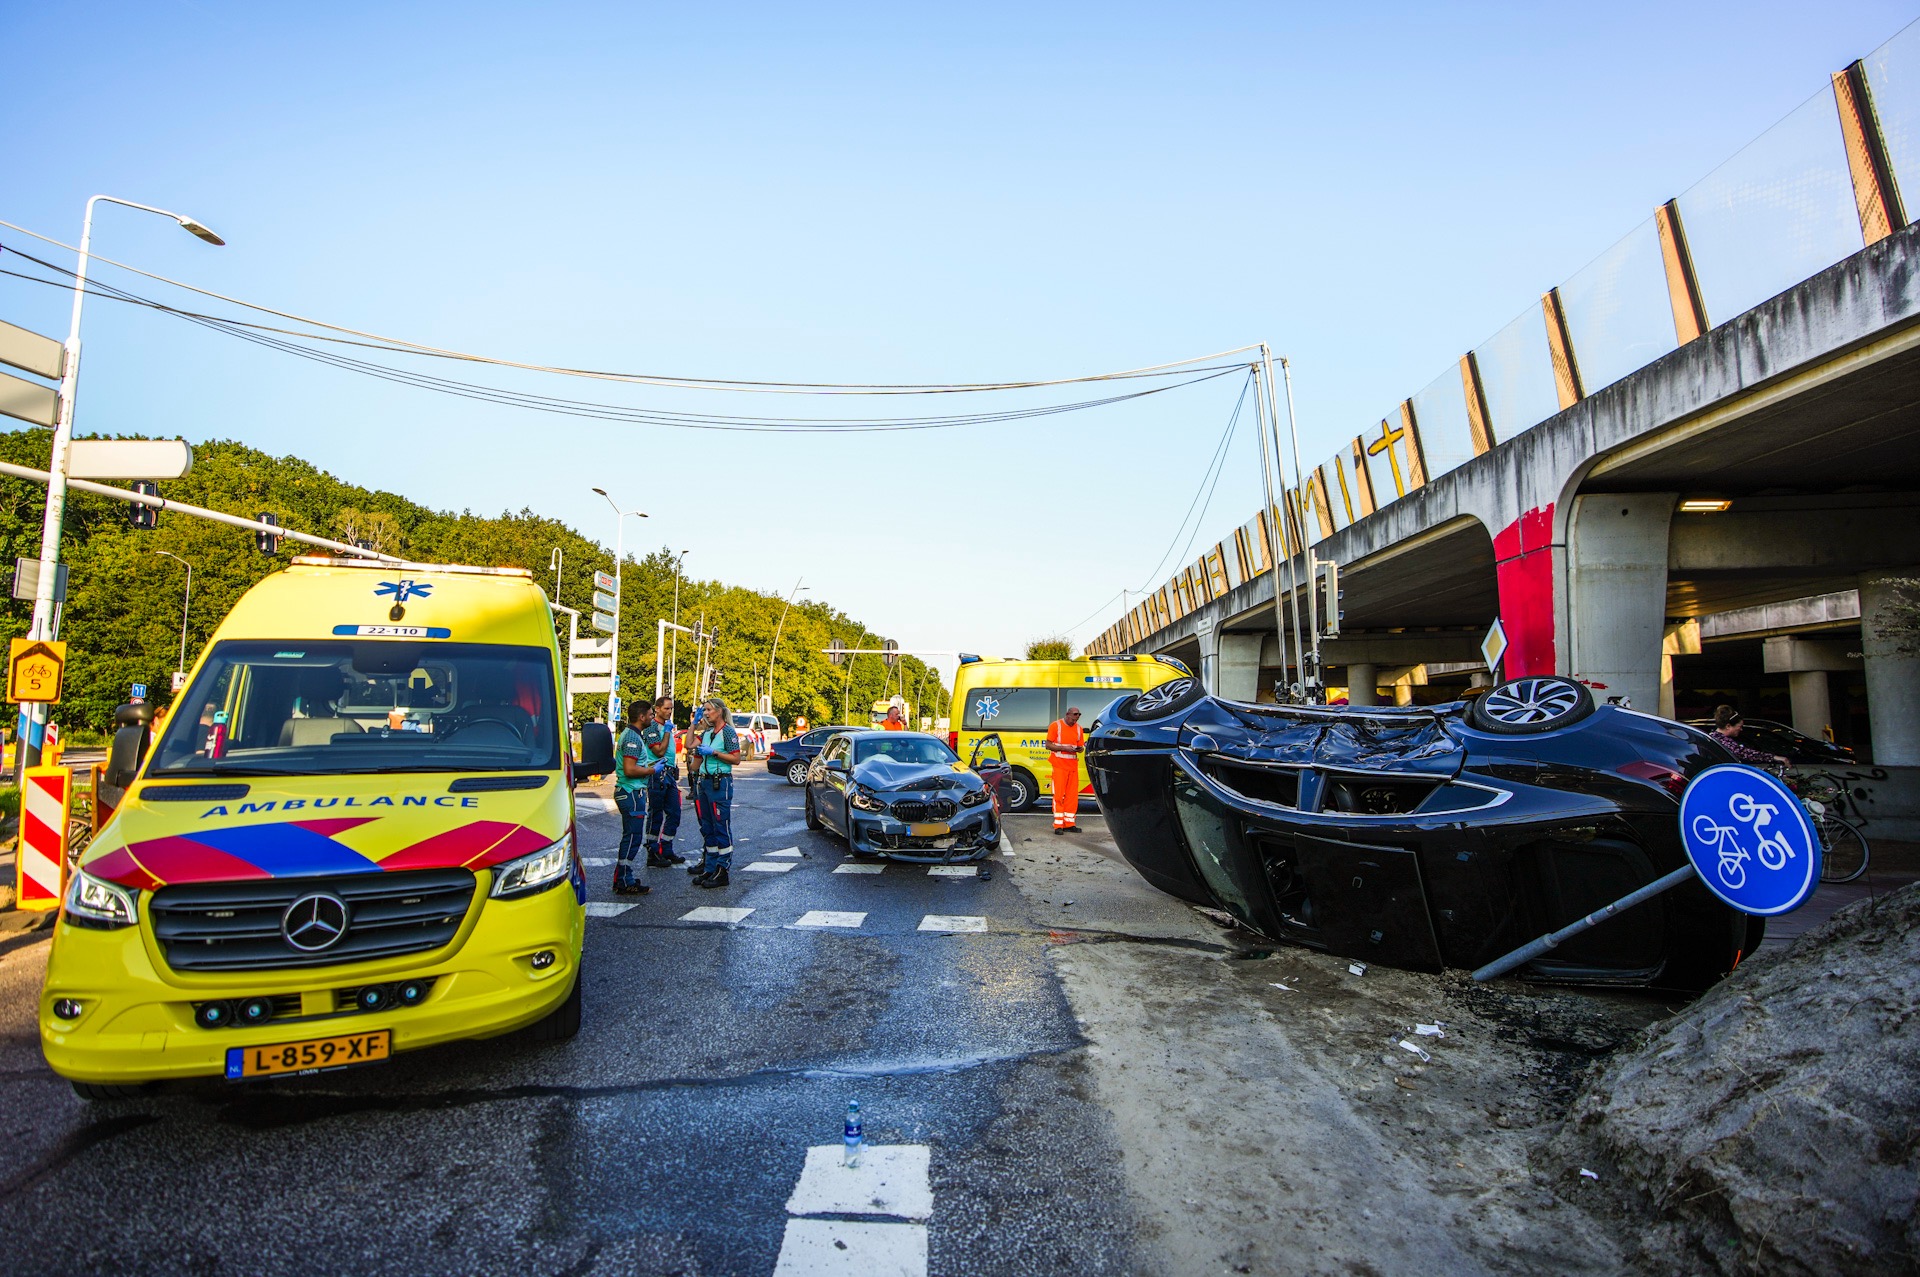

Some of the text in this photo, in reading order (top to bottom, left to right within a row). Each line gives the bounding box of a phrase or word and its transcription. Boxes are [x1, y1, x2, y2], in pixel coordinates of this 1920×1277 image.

[367, 627, 418, 635] 22-110
[30, 679, 41, 690] 5
[199, 796, 479, 818] AMBULANCE
[256, 1036, 380, 1071] L-859-XF
[229, 1065, 240, 1073] NL
